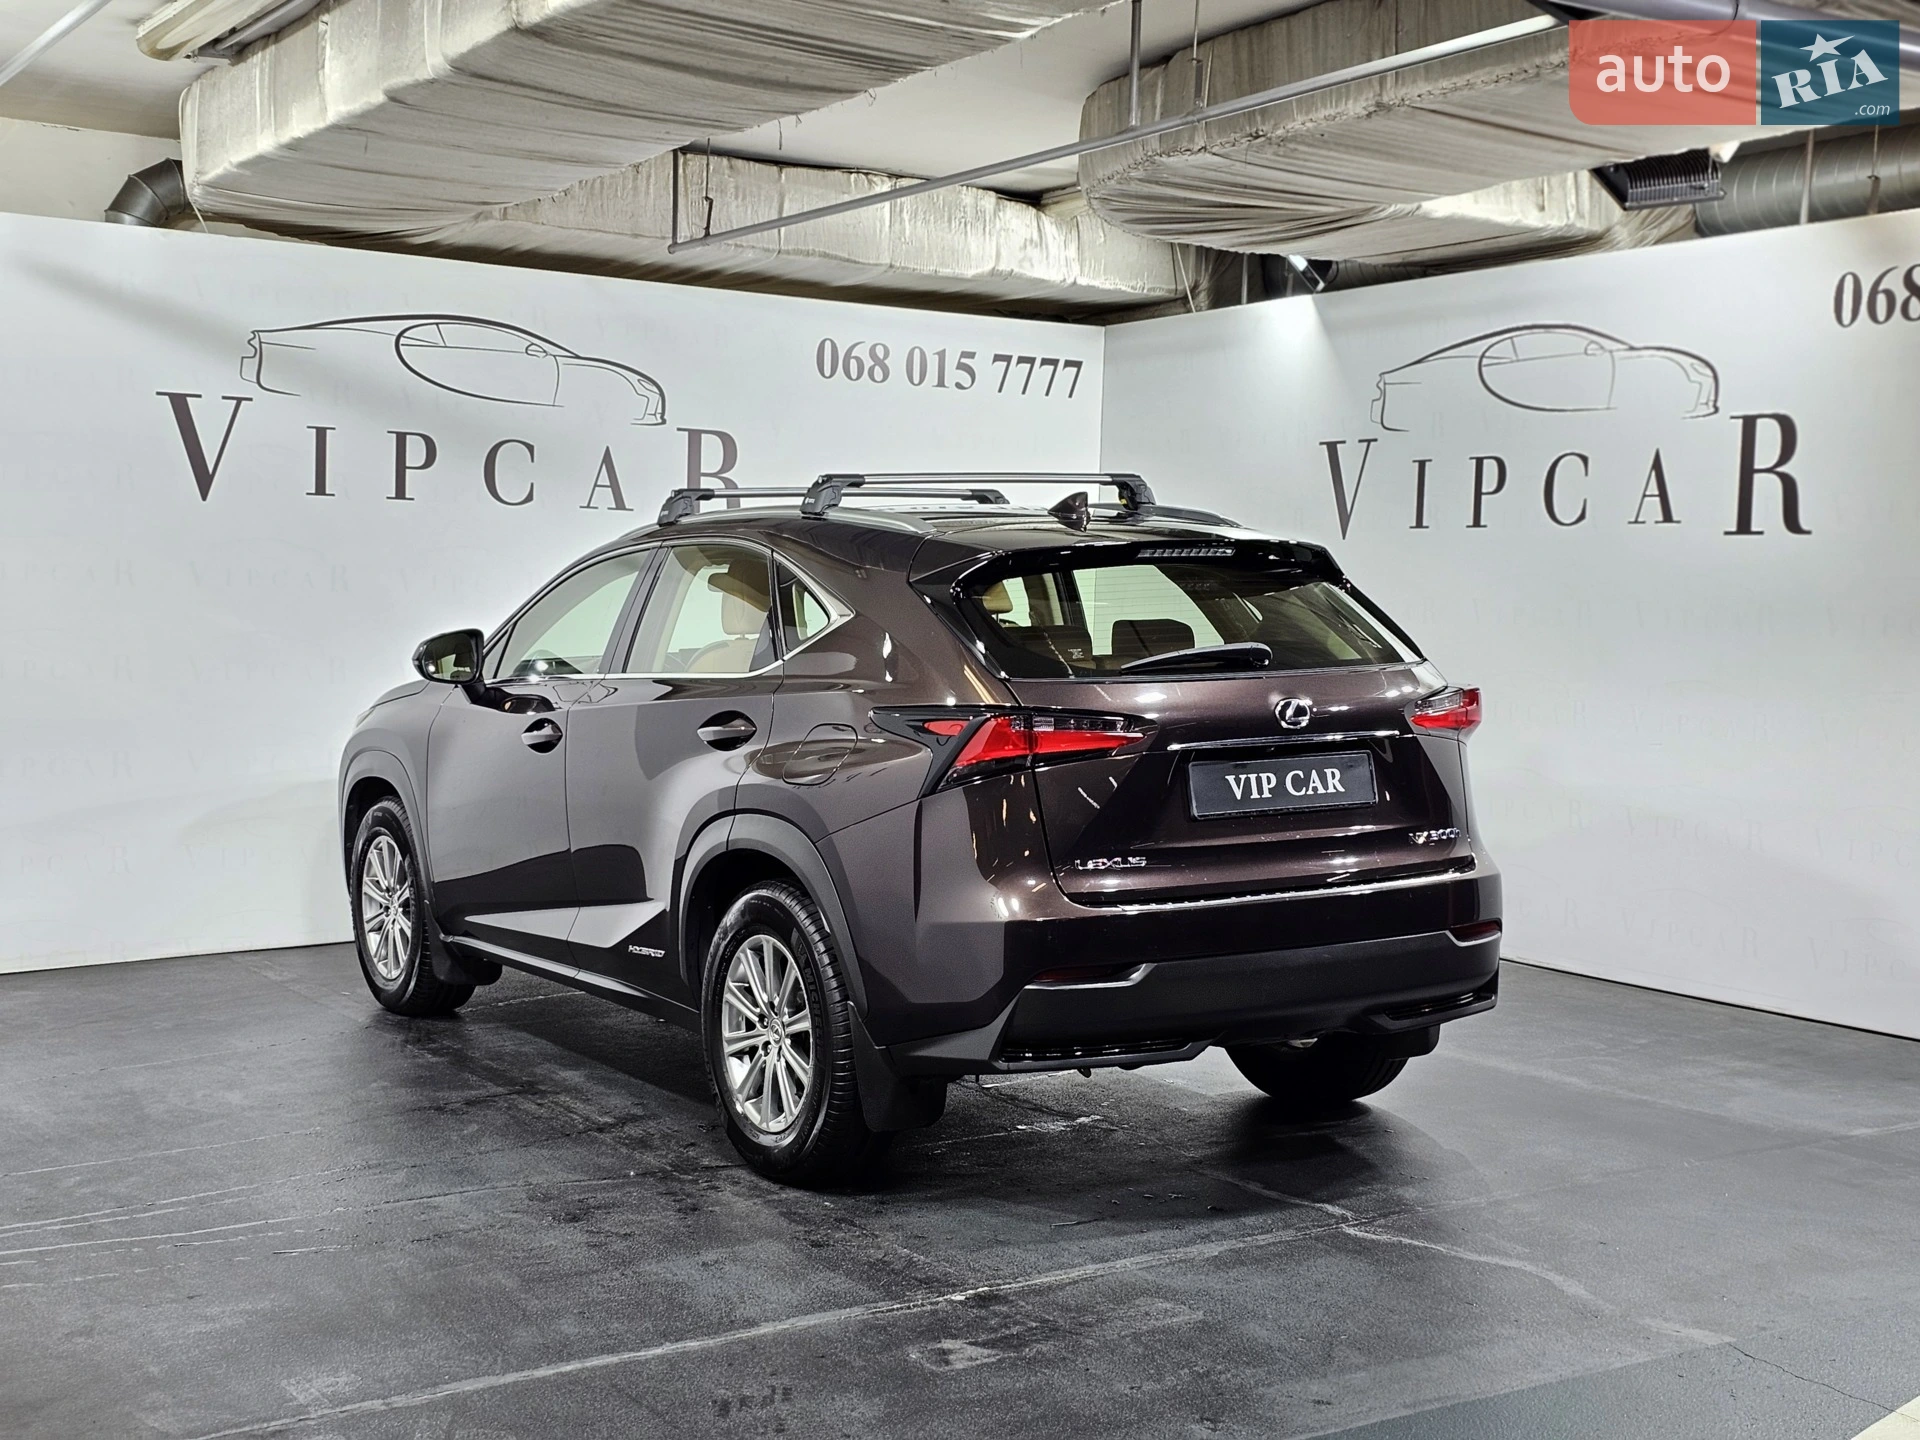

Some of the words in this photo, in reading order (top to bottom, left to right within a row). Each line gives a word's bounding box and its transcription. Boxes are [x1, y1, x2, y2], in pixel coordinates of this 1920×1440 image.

[1834, 263, 1920, 328] 068
[816, 337, 891, 384] 068
[905, 345, 977, 391] 015
[991, 352, 1084, 399] 7777
[1225, 772, 1277, 801] VIP
[1285, 768, 1346, 797] CAR
[1075, 857, 1147, 870] LEXUS
